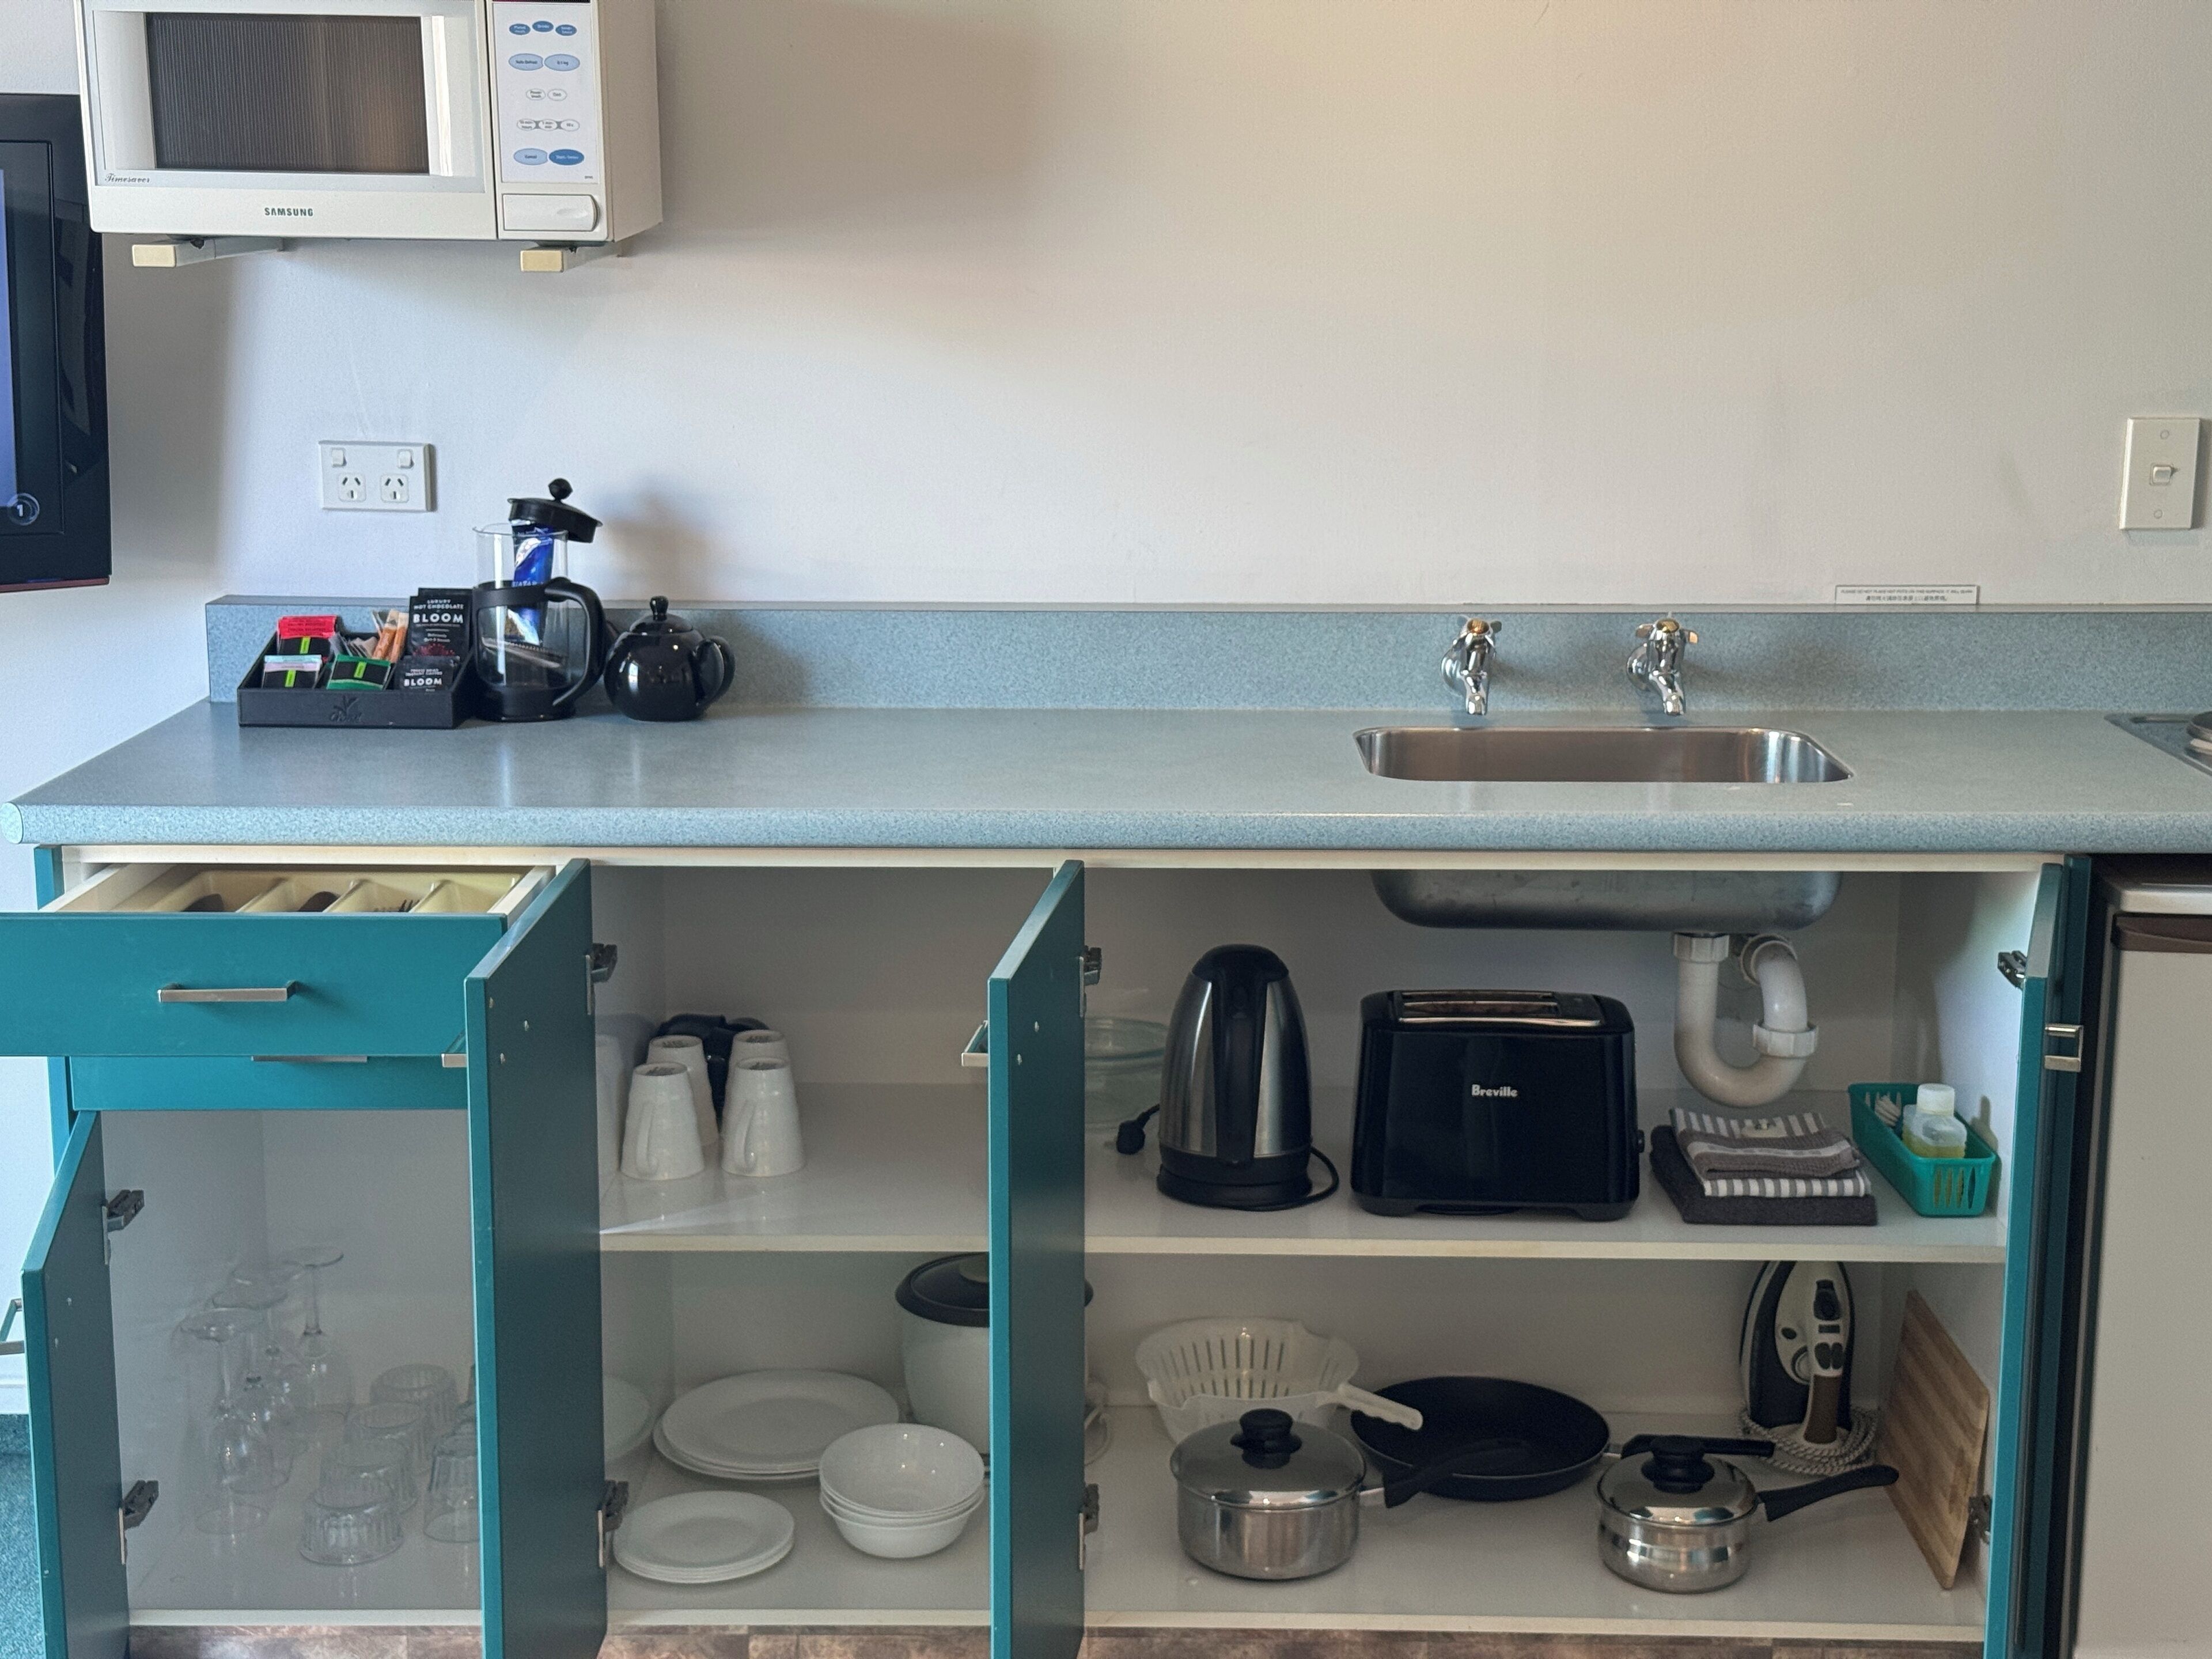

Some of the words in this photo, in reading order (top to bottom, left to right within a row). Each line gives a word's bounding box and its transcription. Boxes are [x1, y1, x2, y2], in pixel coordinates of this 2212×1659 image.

[264, 207, 313, 217] SAMSUNG
[413, 613, 464, 624] BLOOM
[404, 677, 442, 687] BLOOM
[1471, 1084, 1518, 1097] Breville
